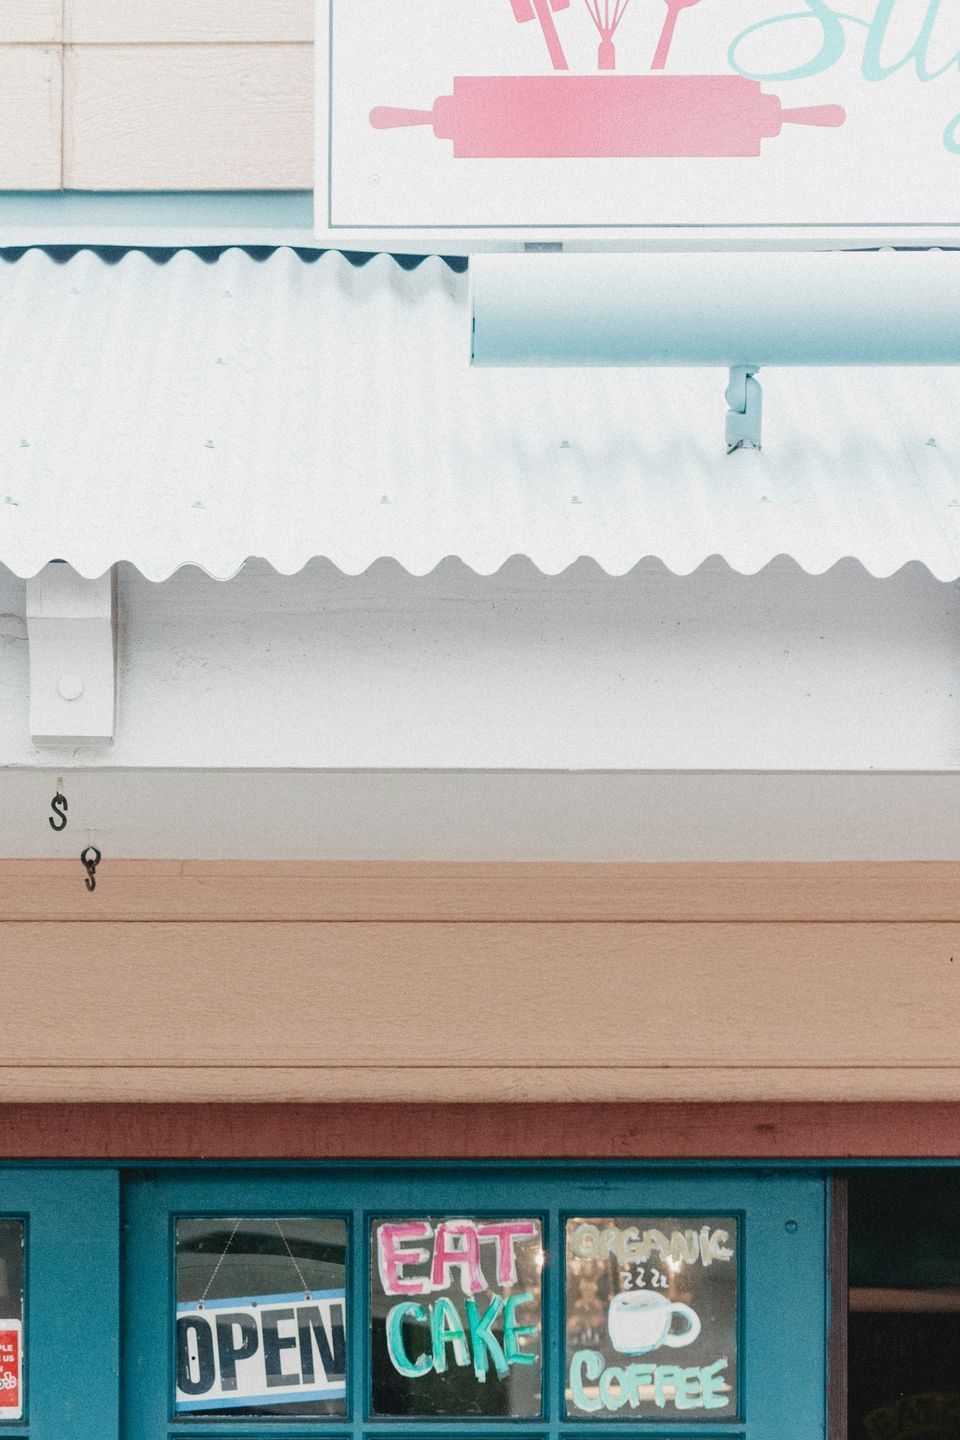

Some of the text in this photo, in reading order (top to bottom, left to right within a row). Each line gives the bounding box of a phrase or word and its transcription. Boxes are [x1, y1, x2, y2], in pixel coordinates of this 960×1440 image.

[377, 1219, 536, 1295] EAT
[3, 1355, 15, 1363] US
[176, 1303, 346, 1395] OPEN
[386, 1291, 540, 1383] CAKE
[569, 1349, 730, 1412] COFFEE
